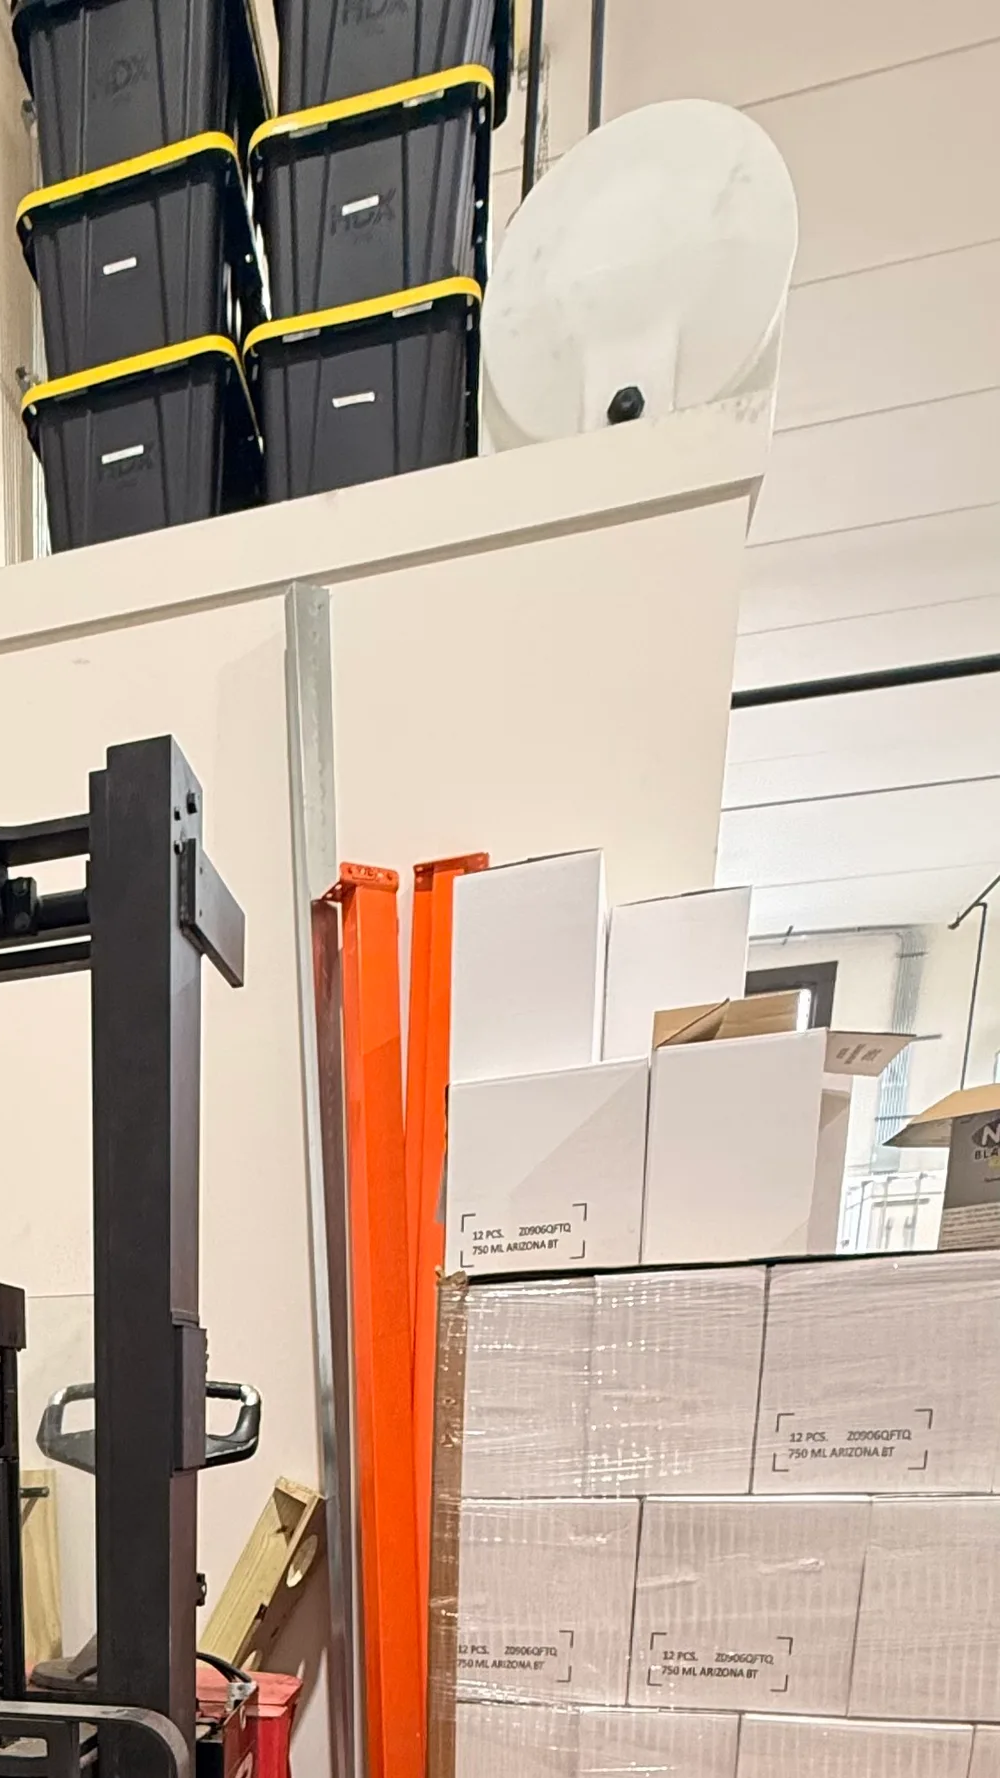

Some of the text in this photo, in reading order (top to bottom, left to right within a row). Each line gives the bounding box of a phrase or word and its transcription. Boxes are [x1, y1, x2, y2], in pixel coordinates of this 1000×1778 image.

[473, 1231, 483, 1241] 12
[486, 1229, 504, 1239] PCS.
[473, 1239, 558, 1255] 750 ML ARIZONA BT
[789, 1432, 802, 1443] 12
[806, 1431, 828, 1442] PCS.
[788, 1448, 807, 1459] 750
[811, 1448, 827, 1458] ML
[829, 1447, 879, 1458] ARIZONA
[471, 1645, 489, 1655] PCS.
[663, 1651, 674, 1661] 12
[677, 1651, 698, 1661] PCS.
[475, 1660, 489, 1668] ML
[491, 1660, 531, 1670] ARIZONA
[661, 1665, 758, 1679] 750 ML ARIZONA BT
